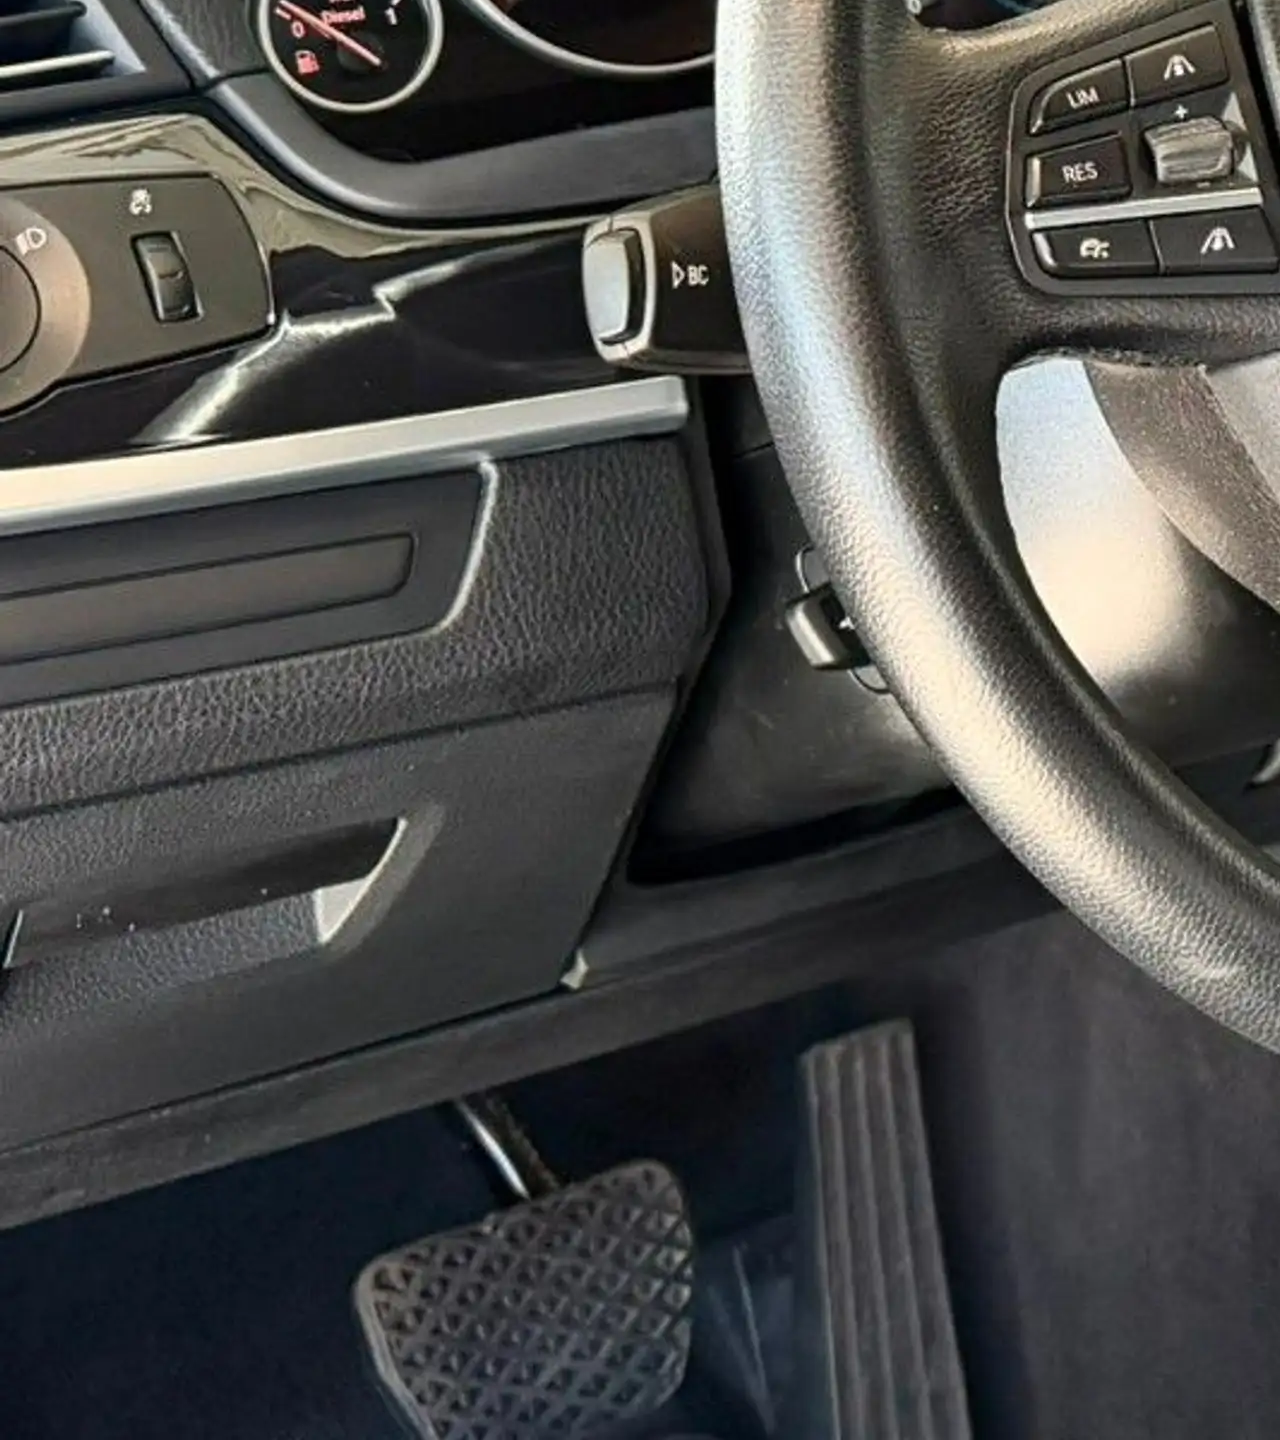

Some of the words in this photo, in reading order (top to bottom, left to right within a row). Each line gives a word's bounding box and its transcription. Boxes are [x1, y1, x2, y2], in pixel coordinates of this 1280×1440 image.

[384, 5, 398, 26] 1
[291, 20, 306, 40] 0
[1065, 85, 1100, 111] LIM
[1061, 161, 1100, 185] RES
[687, 263, 710, 287] BC
